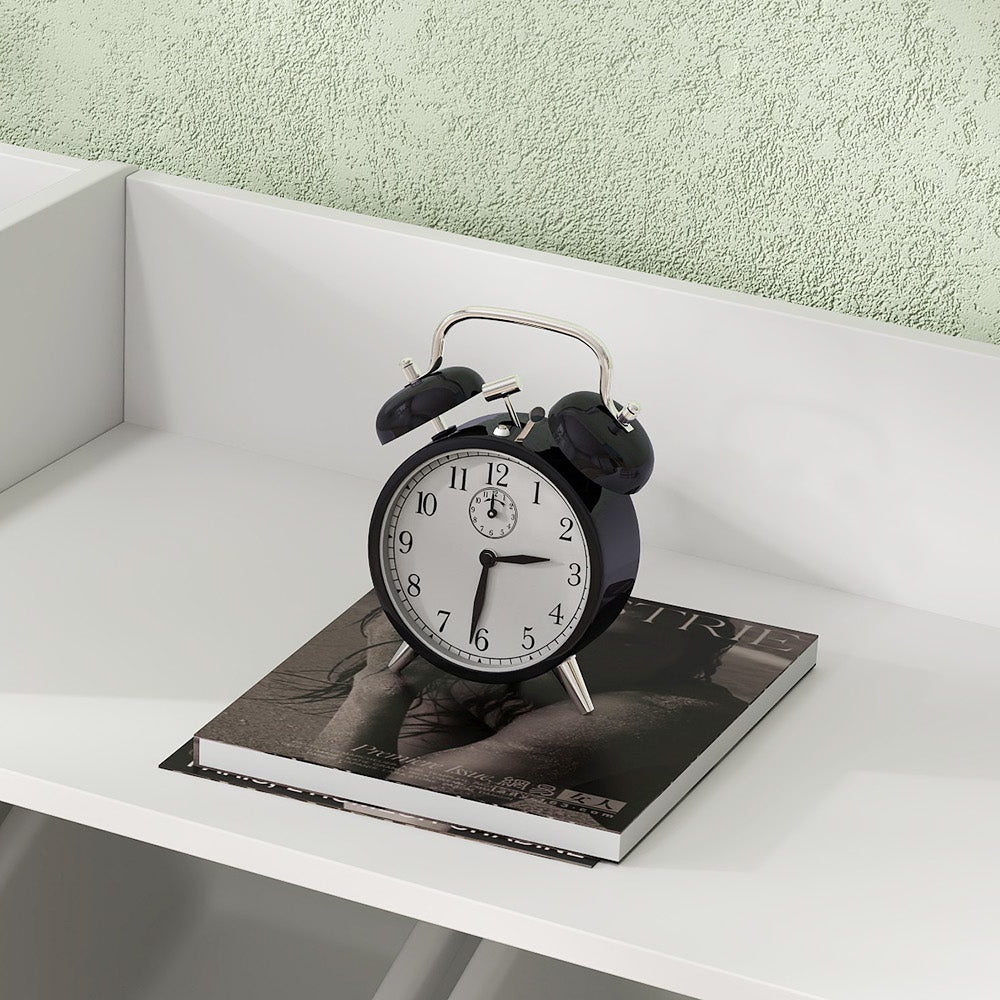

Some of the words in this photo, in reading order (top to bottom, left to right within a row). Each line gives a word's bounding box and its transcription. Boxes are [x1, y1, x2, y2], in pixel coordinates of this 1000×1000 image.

[449, 466, 468, 491] 11
[485, 462, 509, 488] 12
[415, 491, 437, 517] 10
[532, 481, 541, 505] 1
[559, 517, 573, 542] 2
[399, 531, 413, 554] 9
[407, 573, 421, 597] 8
[567, 563, 581, 587] 3
[436, 610, 450, 633] 7
[548, 603, 564, 625] 4
[619, 600, 800, 652] TRIE
[475, 628, 489, 652] 6
[522, 627, 535, 650] 5
